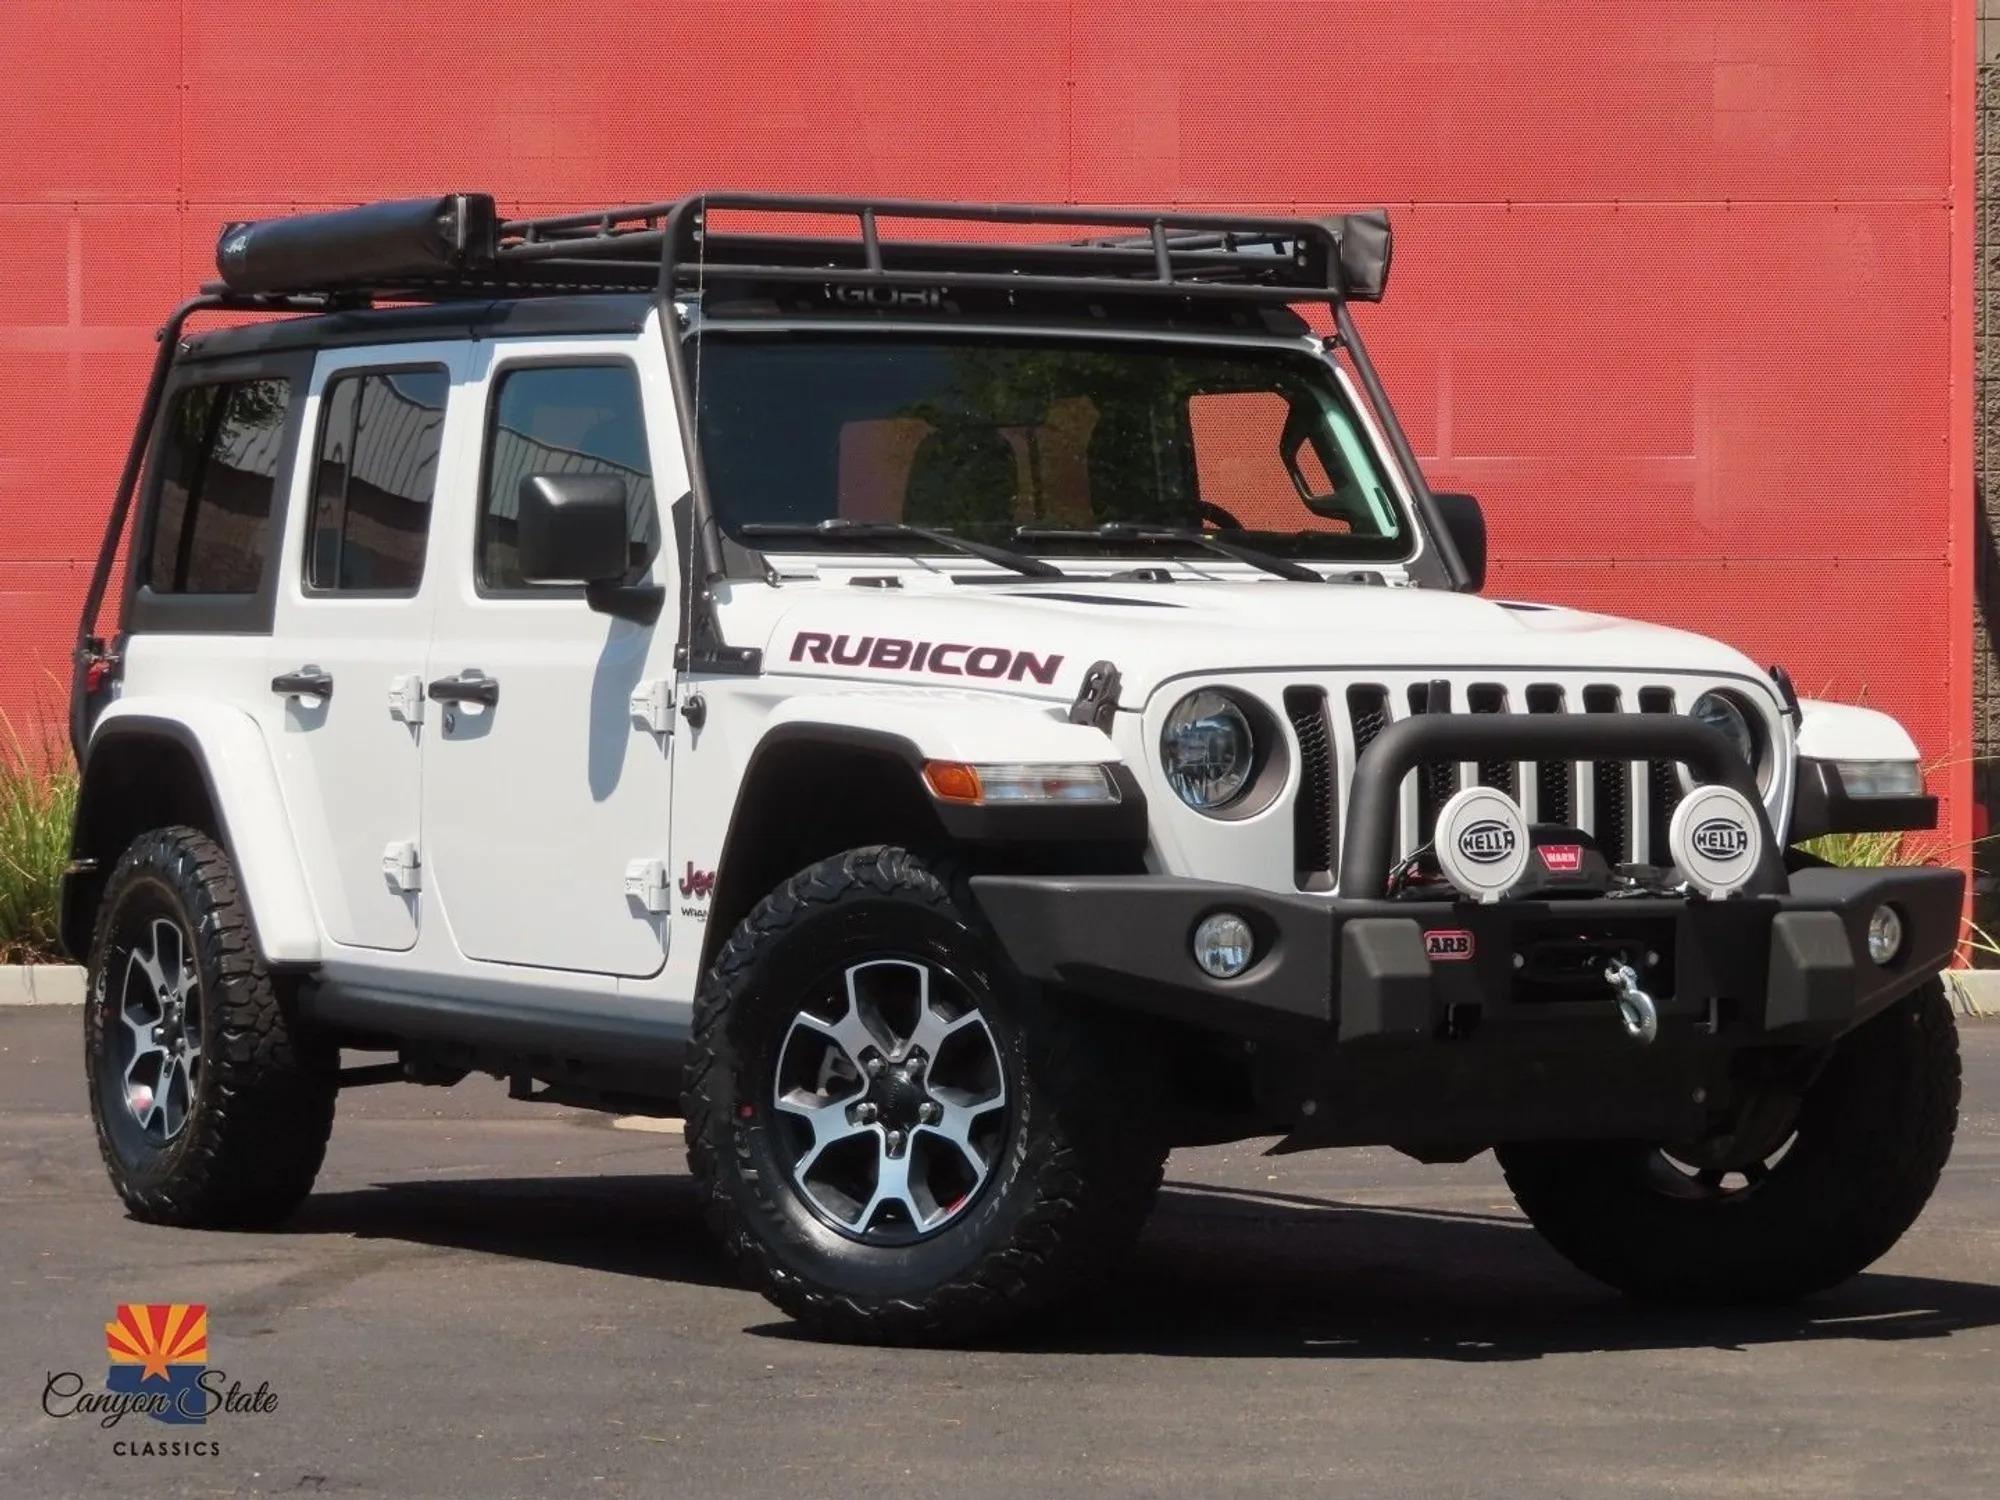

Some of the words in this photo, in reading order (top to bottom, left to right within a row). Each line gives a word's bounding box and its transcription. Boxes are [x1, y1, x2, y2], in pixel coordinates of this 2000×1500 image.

[789, 631, 1065, 685] RUBICON
[1462, 830, 1515, 850] HELLA
[1696, 830, 1748, 850] HELLA
[1428, 936, 1468, 953] ARB
